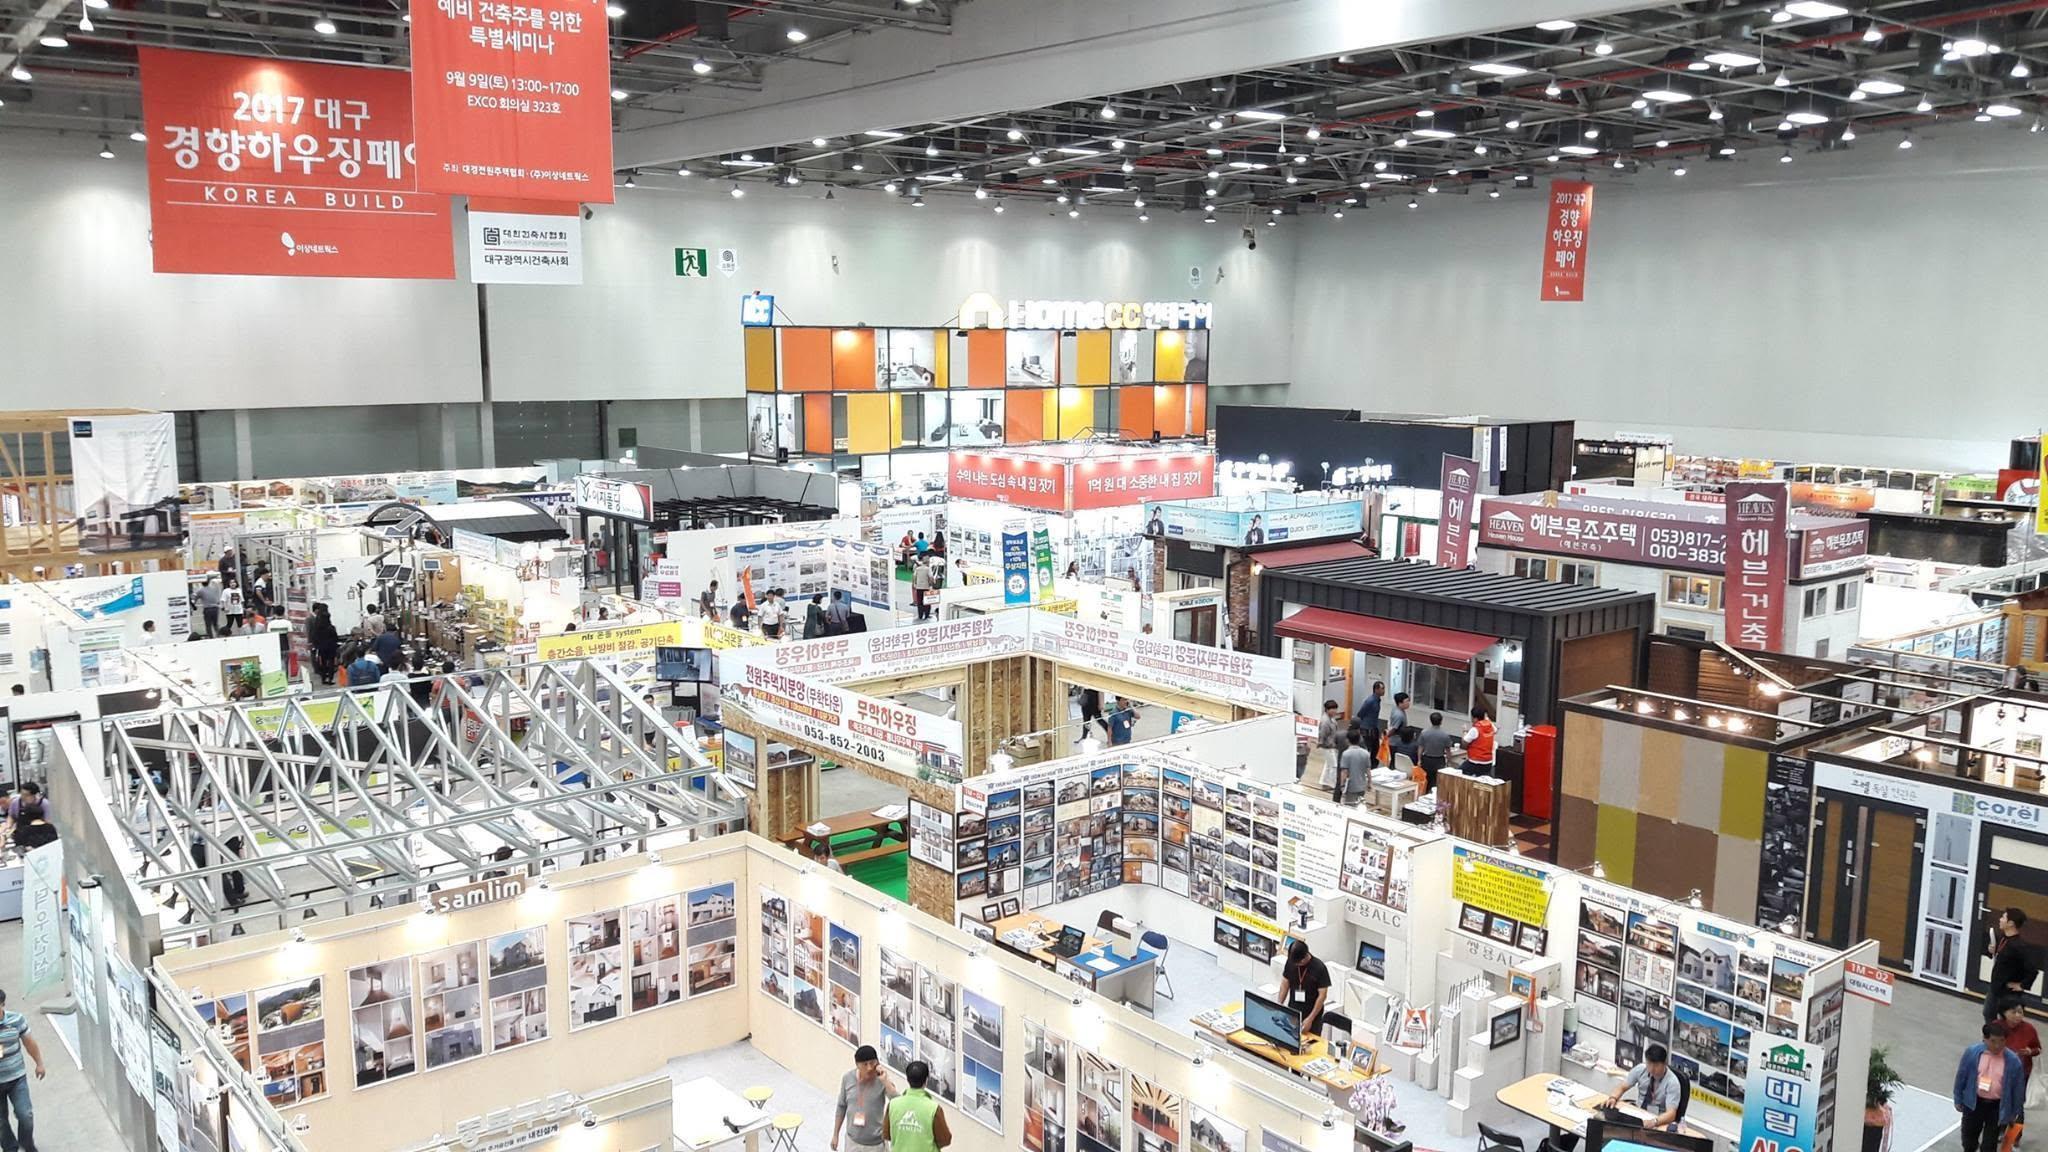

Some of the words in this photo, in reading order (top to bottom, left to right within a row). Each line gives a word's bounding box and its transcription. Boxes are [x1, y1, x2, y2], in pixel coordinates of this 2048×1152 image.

[437, 0, 472, 20] 예비
[479, 2, 545, 29] 건축주를
[549, 11, 582, 33] 위한
[469, 26, 555, 55] 특별세미나
[446, 71, 466, 87] 9월
[468, 75, 509, 91] 9일(토)
[511, 79, 580, 96] 13:00~17:00
[232, 92, 305, 125] 2017
[314, 98, 371, 131] 대구
[467, 95, 497, 107] EXCO
[499, 98, 530, 113] 회의실
[532, 101, 562, 114] 323호
[204, 186, 297, 205] KOREA
[325, 192, 405, 209] BUILD
[1556, 192, 1572, 204] 2017
[1559, 209, 1580, 228] 경향
[1553, 229, 1582, 248] 하우징
[485, 255, 569, 266] 대구광역시건축사회
[1555, 250, 1576, 269] 페어
[956, 469, 973, 483] 수익
[973, 471, 989, 485] 나는
[990, 473, 1006, 488] 도심
[1008, 475, 1017, 489] 속
[1017, 475, 1027, 491] 내
[1028, 477, 1037, 491] 집
[1039, 478, 1056, 494] 짓기
[1087, 478, 1102, 492] 1억
[1104, 477, 1114, 492] 원
[1117, 476, 1127, 490] 대
[1129, 474, 1158, 489] 소중한
[1159, 474, 1169, 488] 내
[1171, 472, 1181, 487] 집
[1183, 470, 1202, 487] 짓기
[1737, 502, 1775, 514] HEAVEN
[1488, 519, 1525, 534] HEAVEN
[1530, 513, 1637, 547] 헤븐목조주택
[588, 642, 615, 655] 난방비
[745, 664, 806, 702] 전원주택지분양
[806, 686, 843, 714] (무학타운)
[857, 700, 917, 736] 무학하우징
[804, 724, 885, 761] 053-852-2003
[1975, 798, 2040, 822] corël
[438, 880, 522, 912] samlim
[1763, 1076, 1802, 1137] 대림
[528, 1124, 559, 1138] 내진설계
